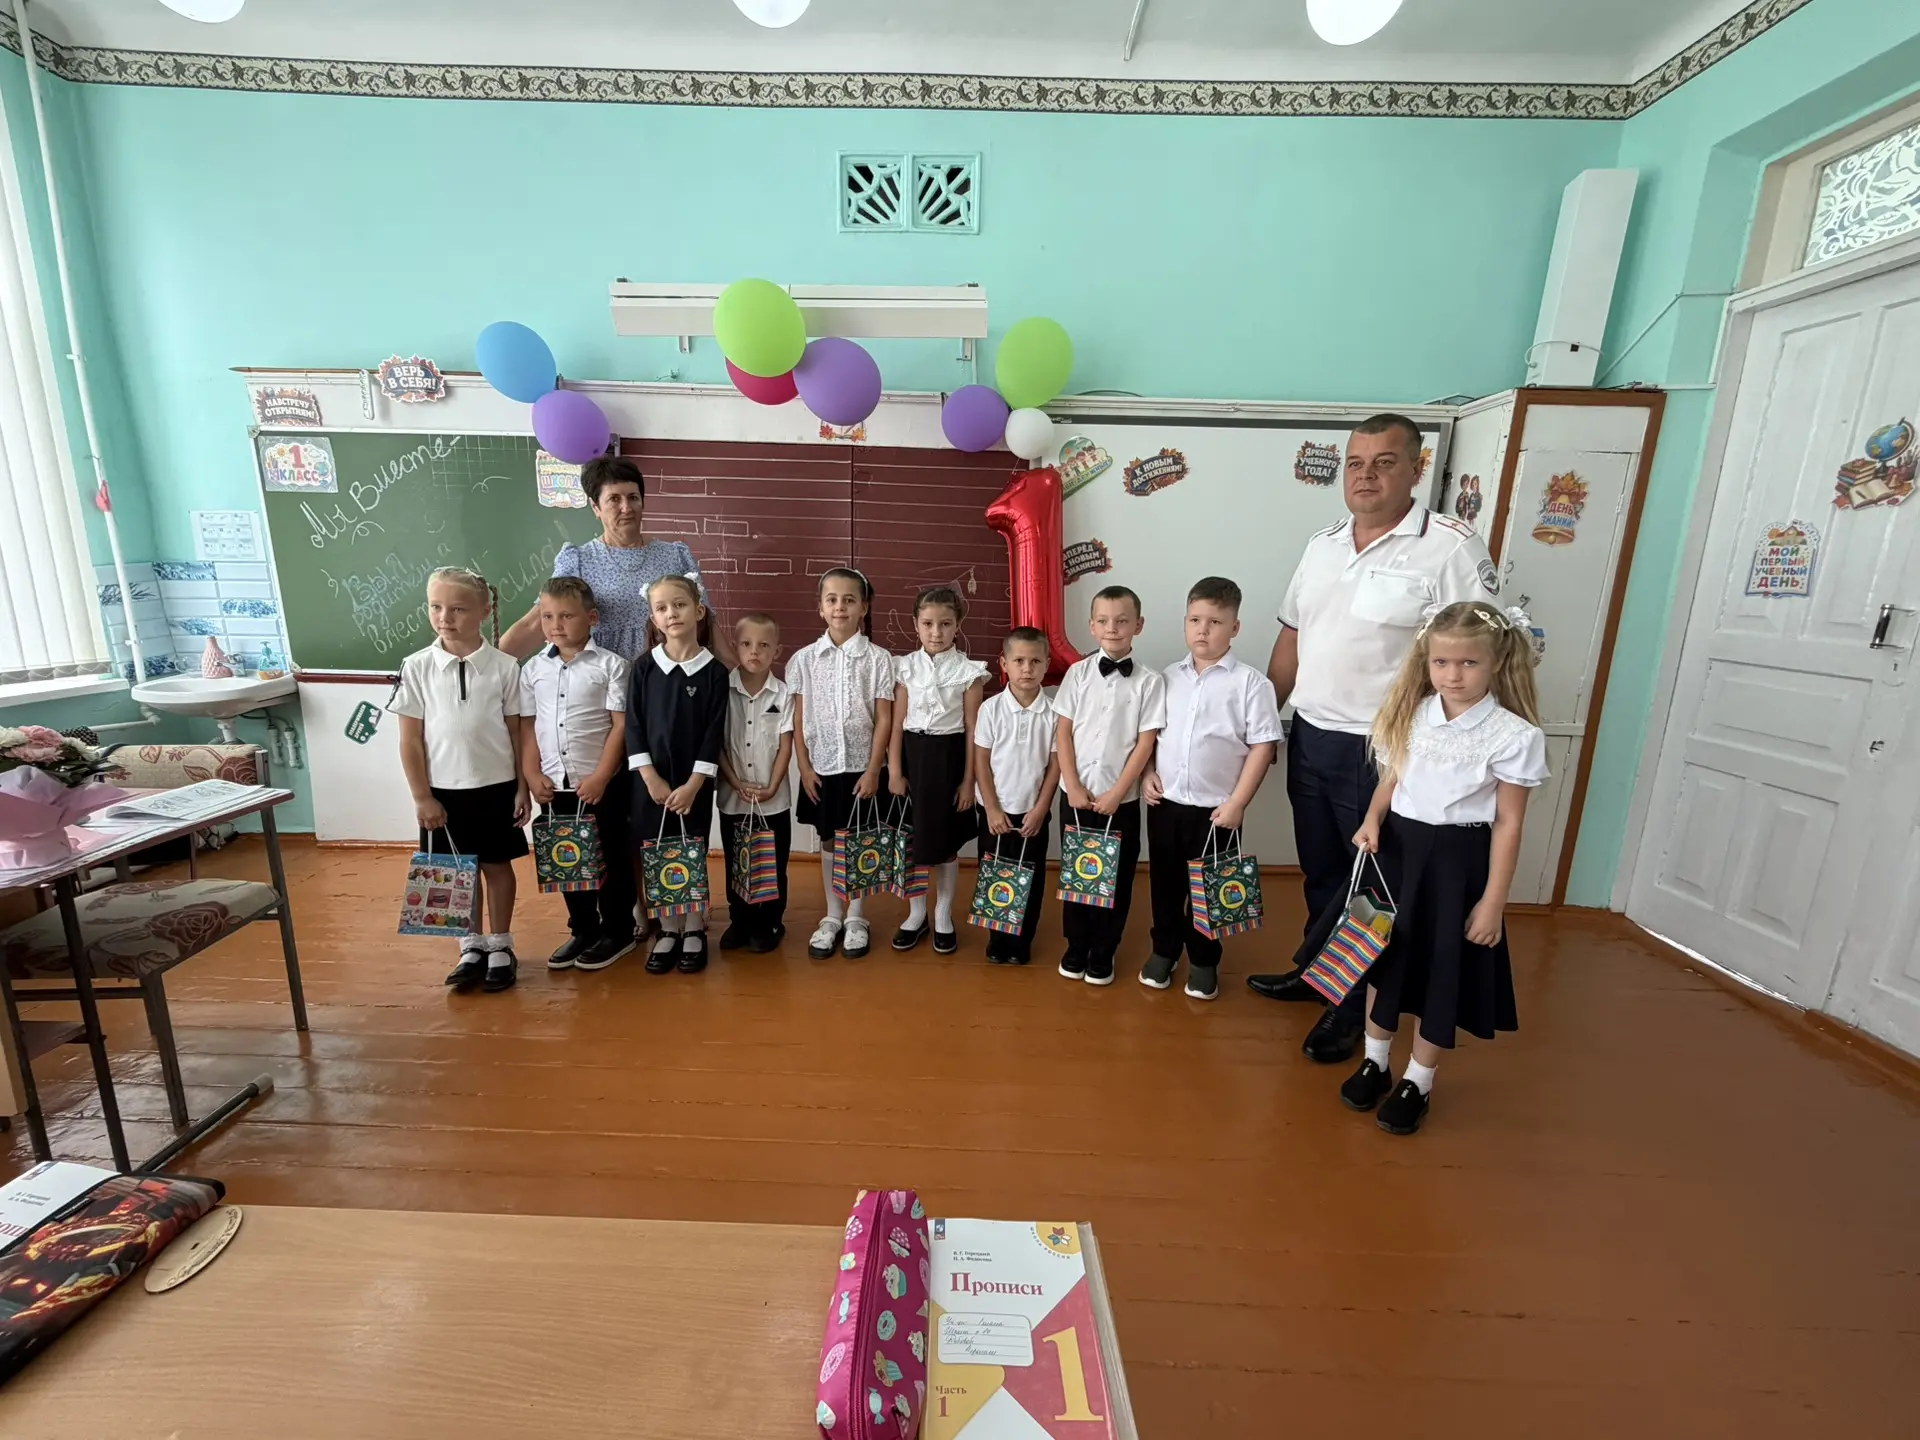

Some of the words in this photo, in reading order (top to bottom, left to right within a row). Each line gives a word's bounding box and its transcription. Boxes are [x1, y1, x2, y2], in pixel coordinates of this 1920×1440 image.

[393, 366, 425, 378] ВЕРЬ
[387, 378, 398, 389] В
[400, 377, 437, 389] СЕБЯ!
[265, 398, 310, 409] НАВСТРЕЧУ
[265, 408, 316, 418] ОТКРЫТИЯМ!
[289, 445, 305, 468] 1
[1304, 448, 1334, 458] ЯРКОГО
[1135, 467, 1143, 476] К
[1143, 457, 1173, 473] НОВЫМ
[1300, 457, 1337, 468] УЧЕБНОГО
[1132, 464, 1183, 488] ДОСТИЖЕНИЯМ!
[1305, 466, 1332, 477] ГОДА!
[1548, 502, 1574, 515] ДЕНЬ
[300, 501, 358, 548] Мы
[1769, 545, 1800, 557] МОЙ
[1068, 552, 1100, 566] НОВЫМ
[1760, 557, 1805, 566] ПЕРВЫЙ
[1065, 558, 1105, 576] ЗНАНИЯМ!
[1755, 565, 1808, 576] УЧЕБНЫЙ
[1757, 576, 1800, 588] ДЕНЬ
[950, 1272, 1043, 1296] Прописи
[1042, 1327, 1104, 1421] 1
[935, 1385, 967, 1395] Часть
[936, 1396, 949, 1417] 1
